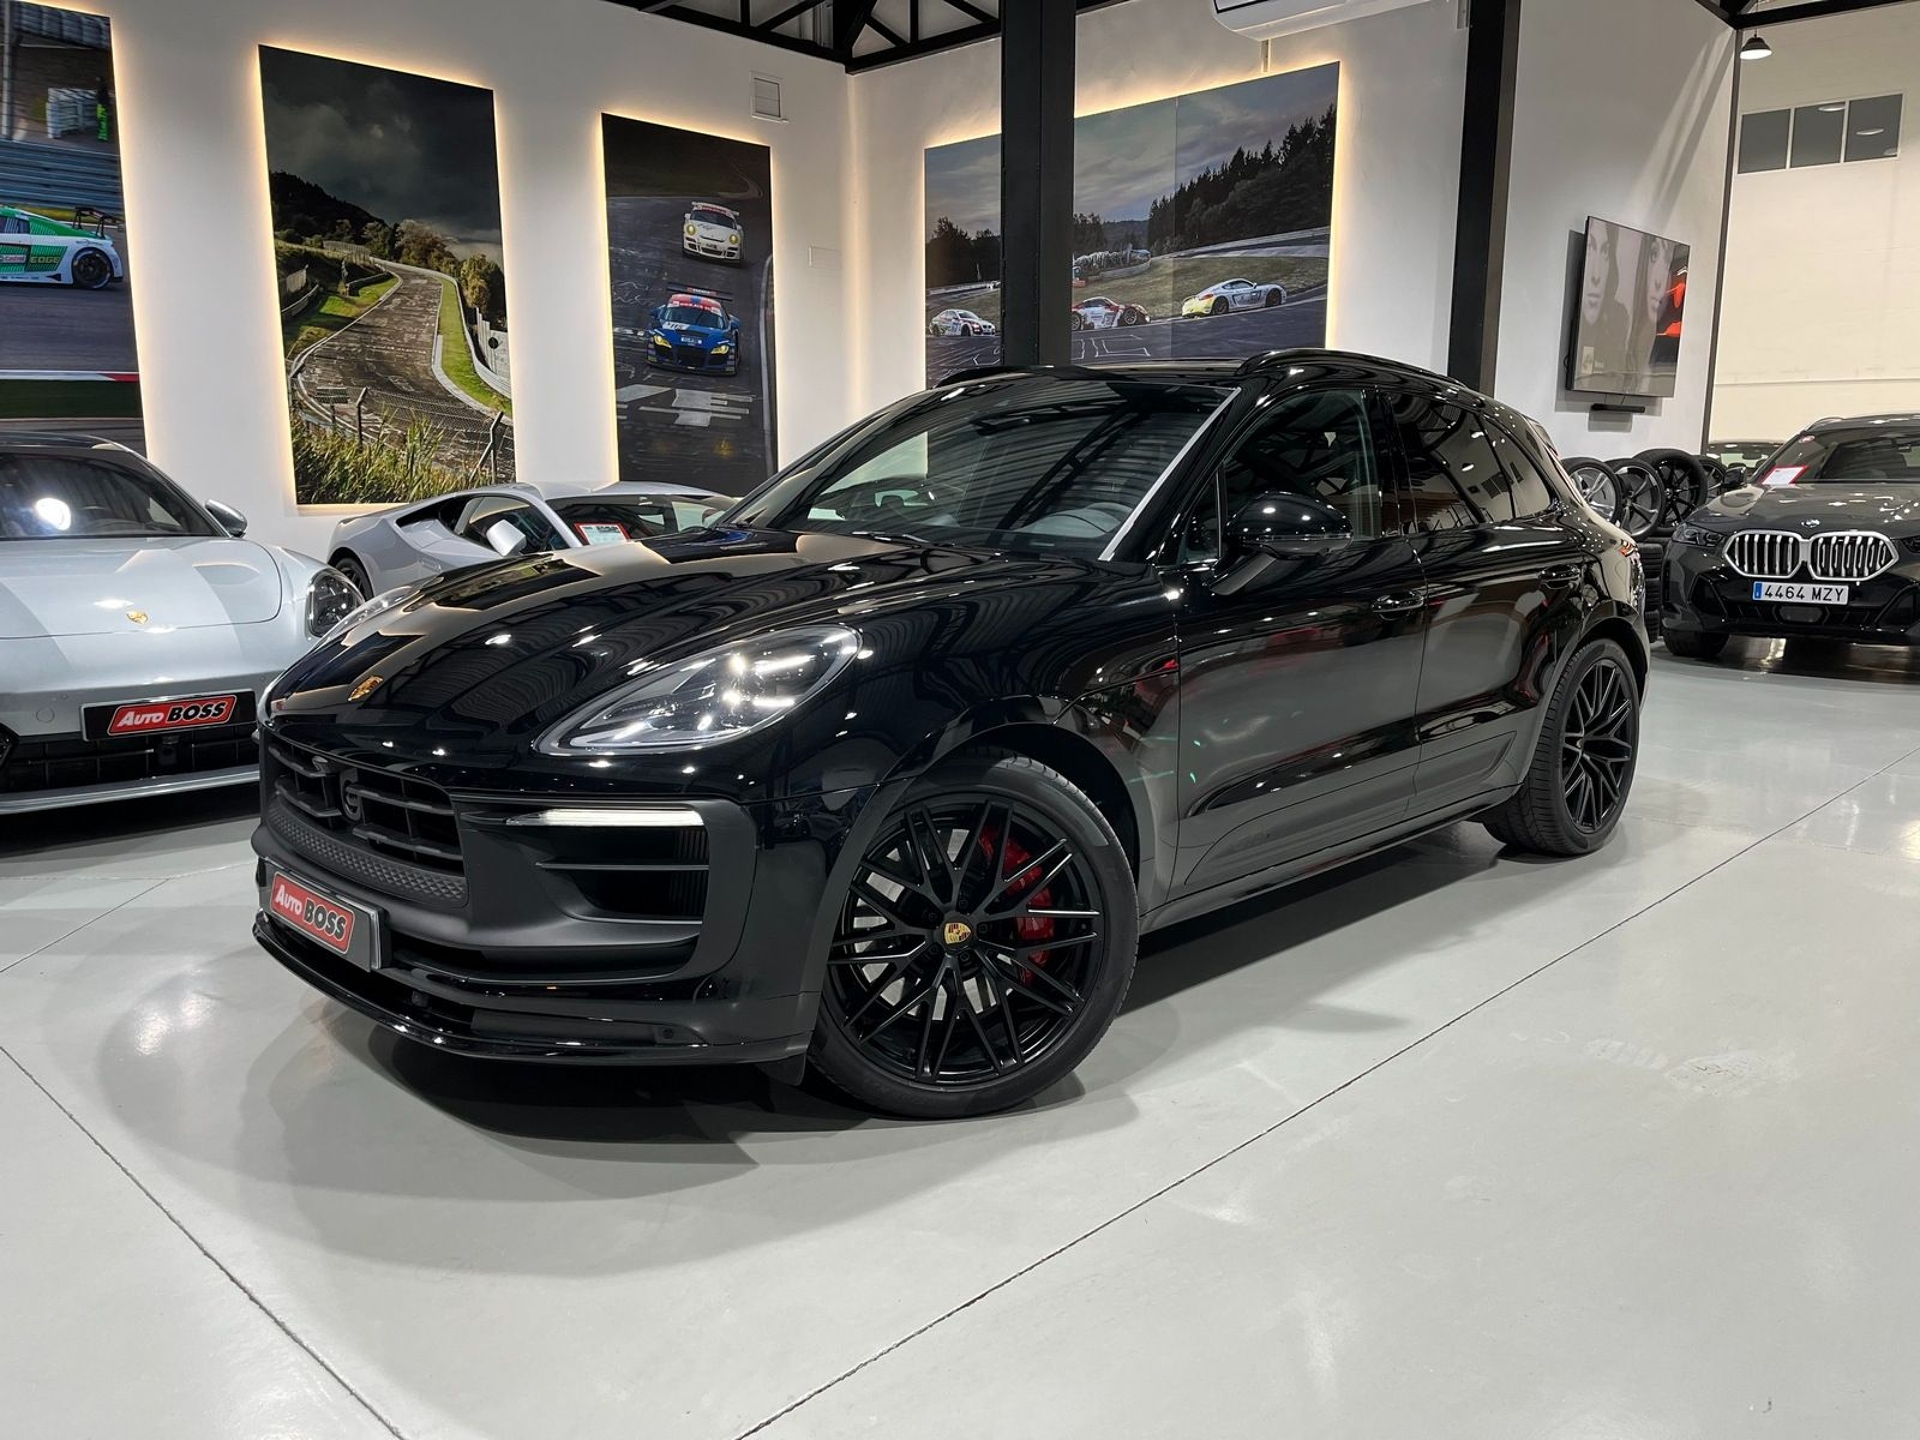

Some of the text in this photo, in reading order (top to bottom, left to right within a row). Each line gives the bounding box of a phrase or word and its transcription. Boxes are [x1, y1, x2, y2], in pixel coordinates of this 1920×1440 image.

[30, 256, 61, 264] EDGE
[1764, 585, 1805, 599] 4464
[1811, 587, 1844, 601] MZY
[166, 701, 227, 723] BOSS
[303, 897, 347, 941] BOSS
